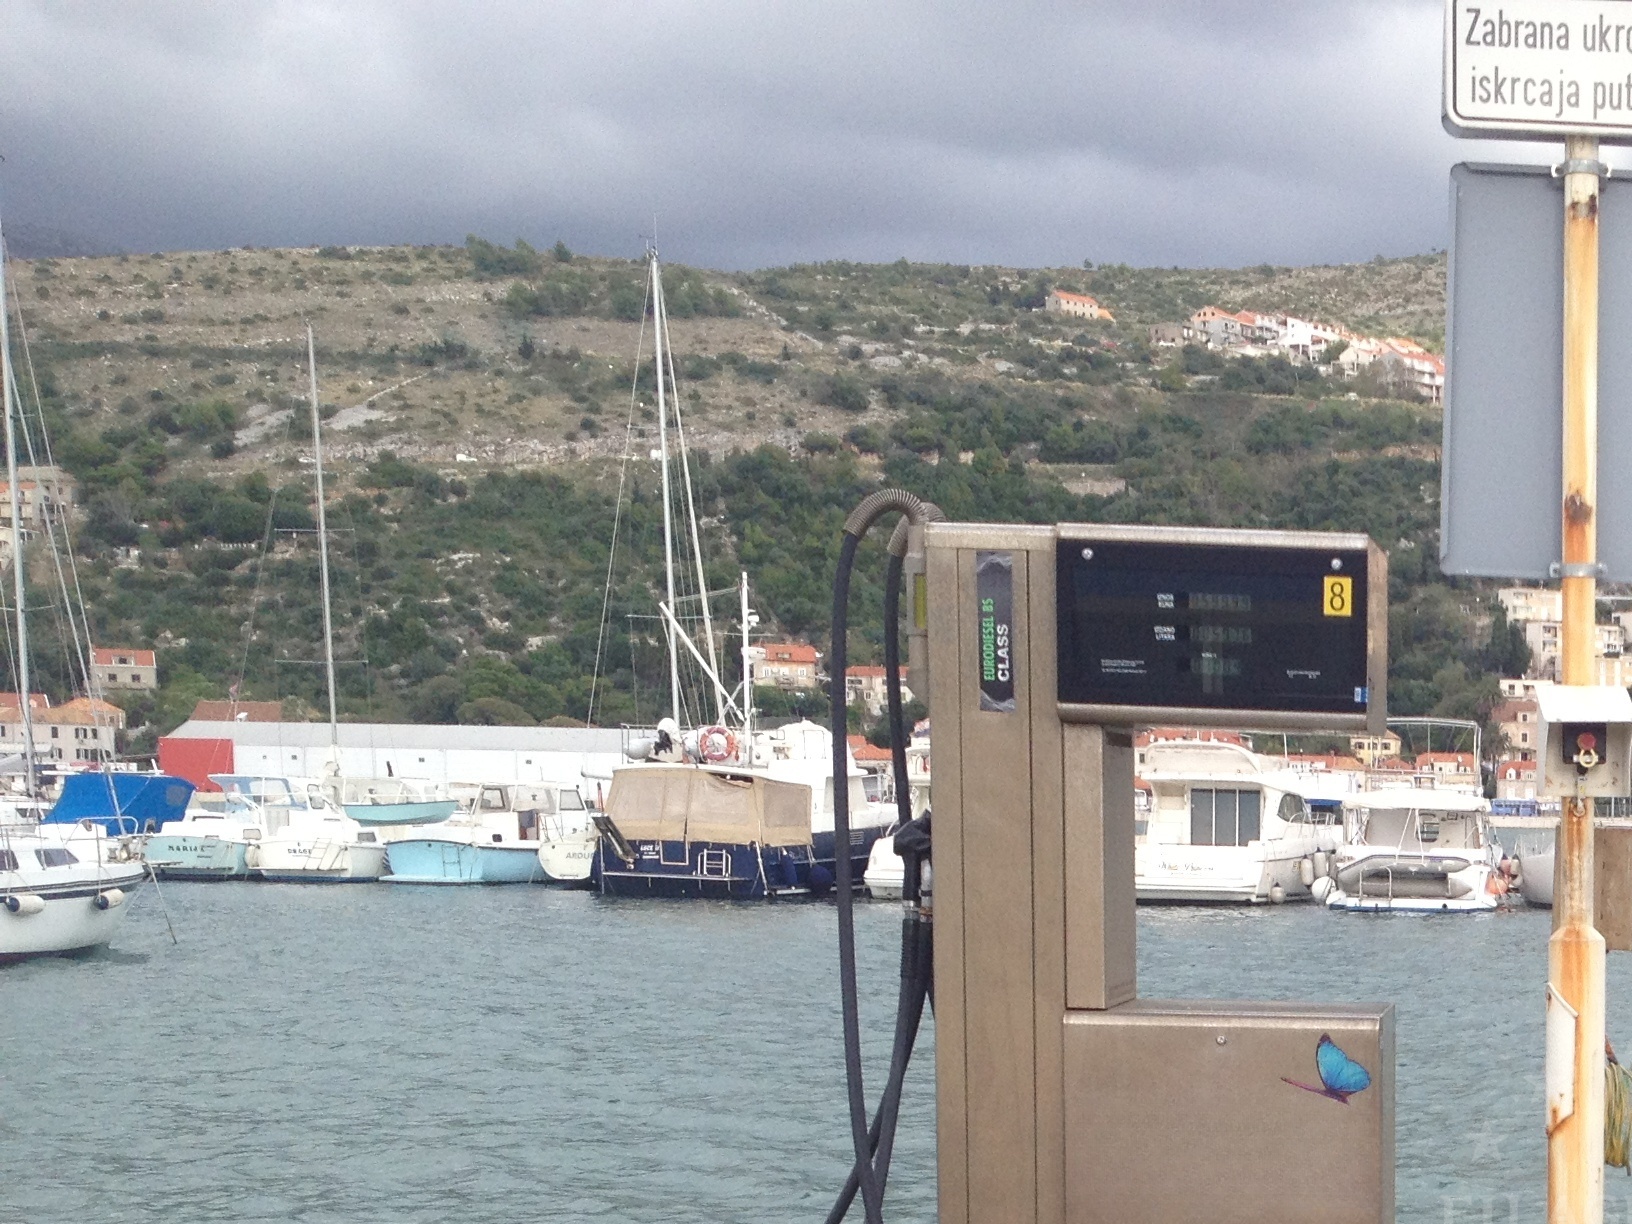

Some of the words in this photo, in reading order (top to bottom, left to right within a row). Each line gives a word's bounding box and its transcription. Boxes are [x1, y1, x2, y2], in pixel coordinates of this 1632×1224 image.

[1465, 8, 1570, 50] Zabrana
[1471, 66, 1580, 118] iskrcaja
[1330, 581, 1345, 611] 8
[982, 616, 995, 681] EURODIESEL
[997, 624, 1010, 682] CLASS
